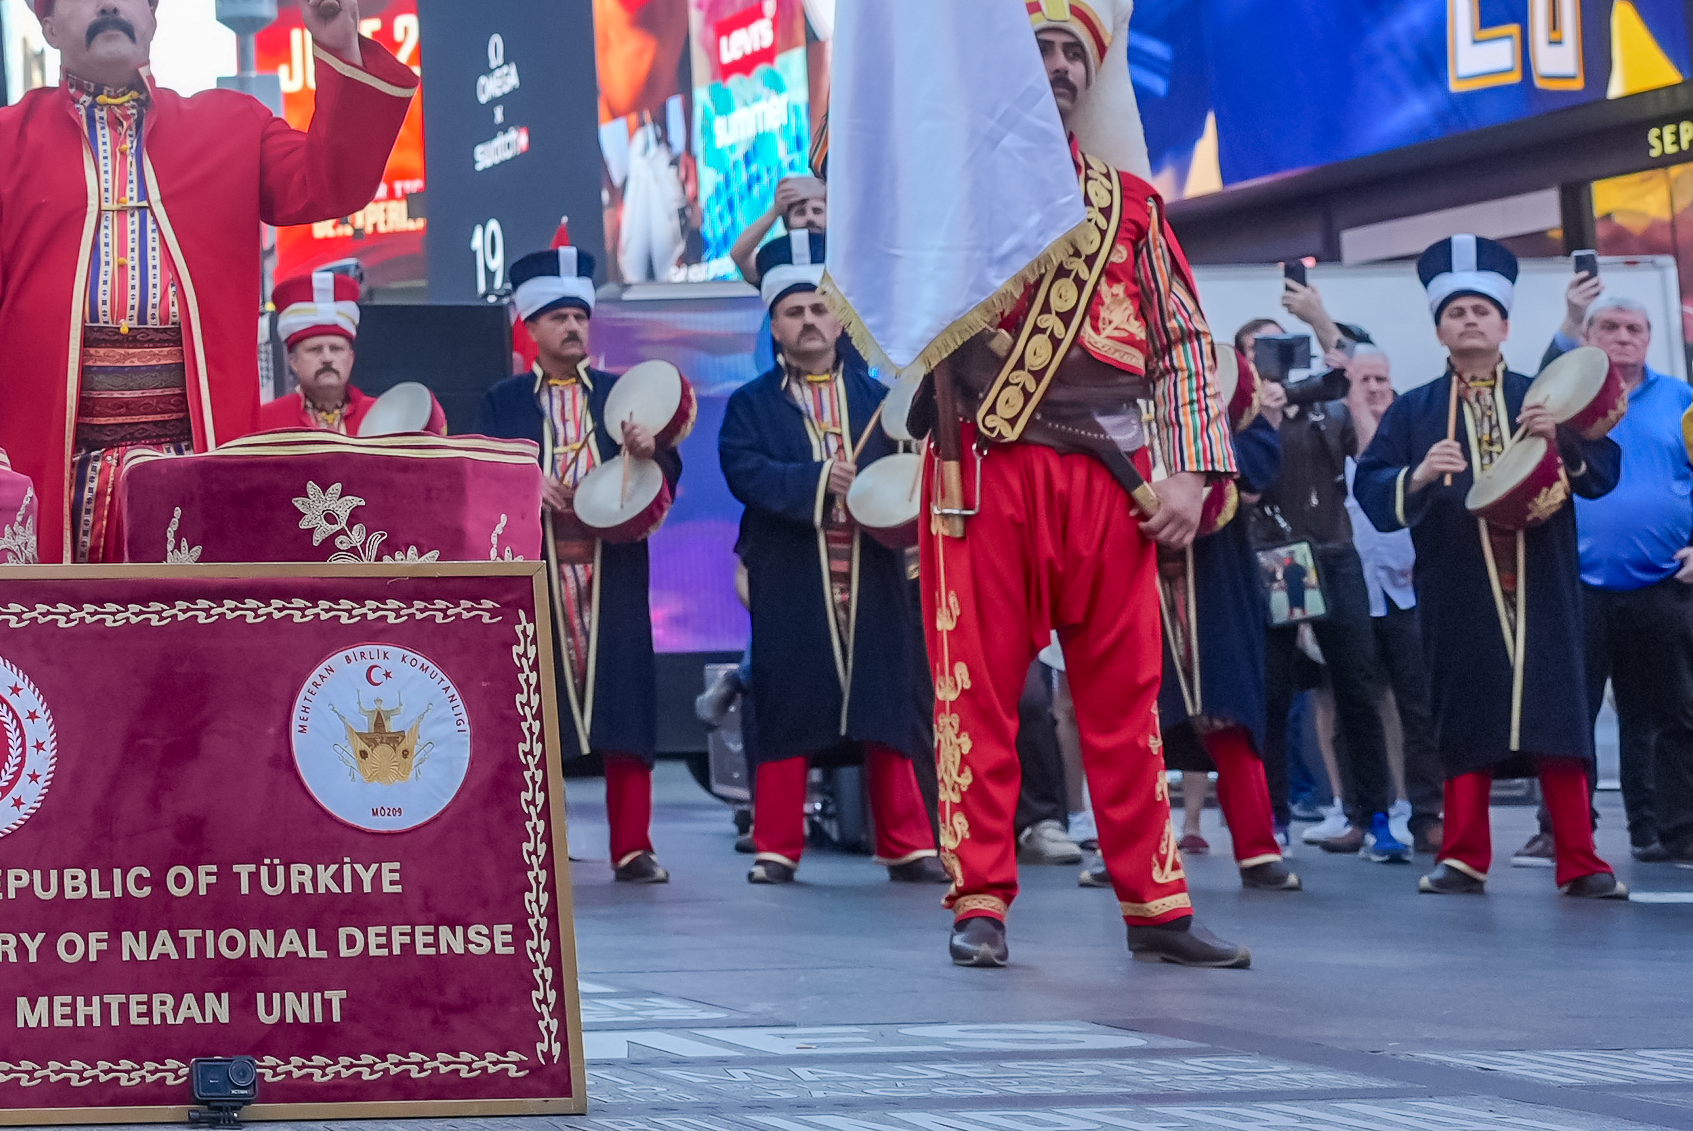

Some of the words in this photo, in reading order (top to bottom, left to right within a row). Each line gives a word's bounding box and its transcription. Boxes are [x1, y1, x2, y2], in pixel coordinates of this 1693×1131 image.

[1647, 119, 1693, 158] SEP
[470, 218, 505, 297] 19
[297, 665, 335, 735] MEHTERAN
[165, 864, 218, 897] OF
[232, 856, 403, 896] TÜRKİYE
[56, 931, 109, 964] OF
[121, 927, 327, 962] NATIONAL
[337, 923, 515, 957] DEFENSE
[15, 991, 230, 1029] MEHTERAN
[256, 989, 347, 1024] UNIT
[656, 1058, 1292, 1083] MAJESTIC
